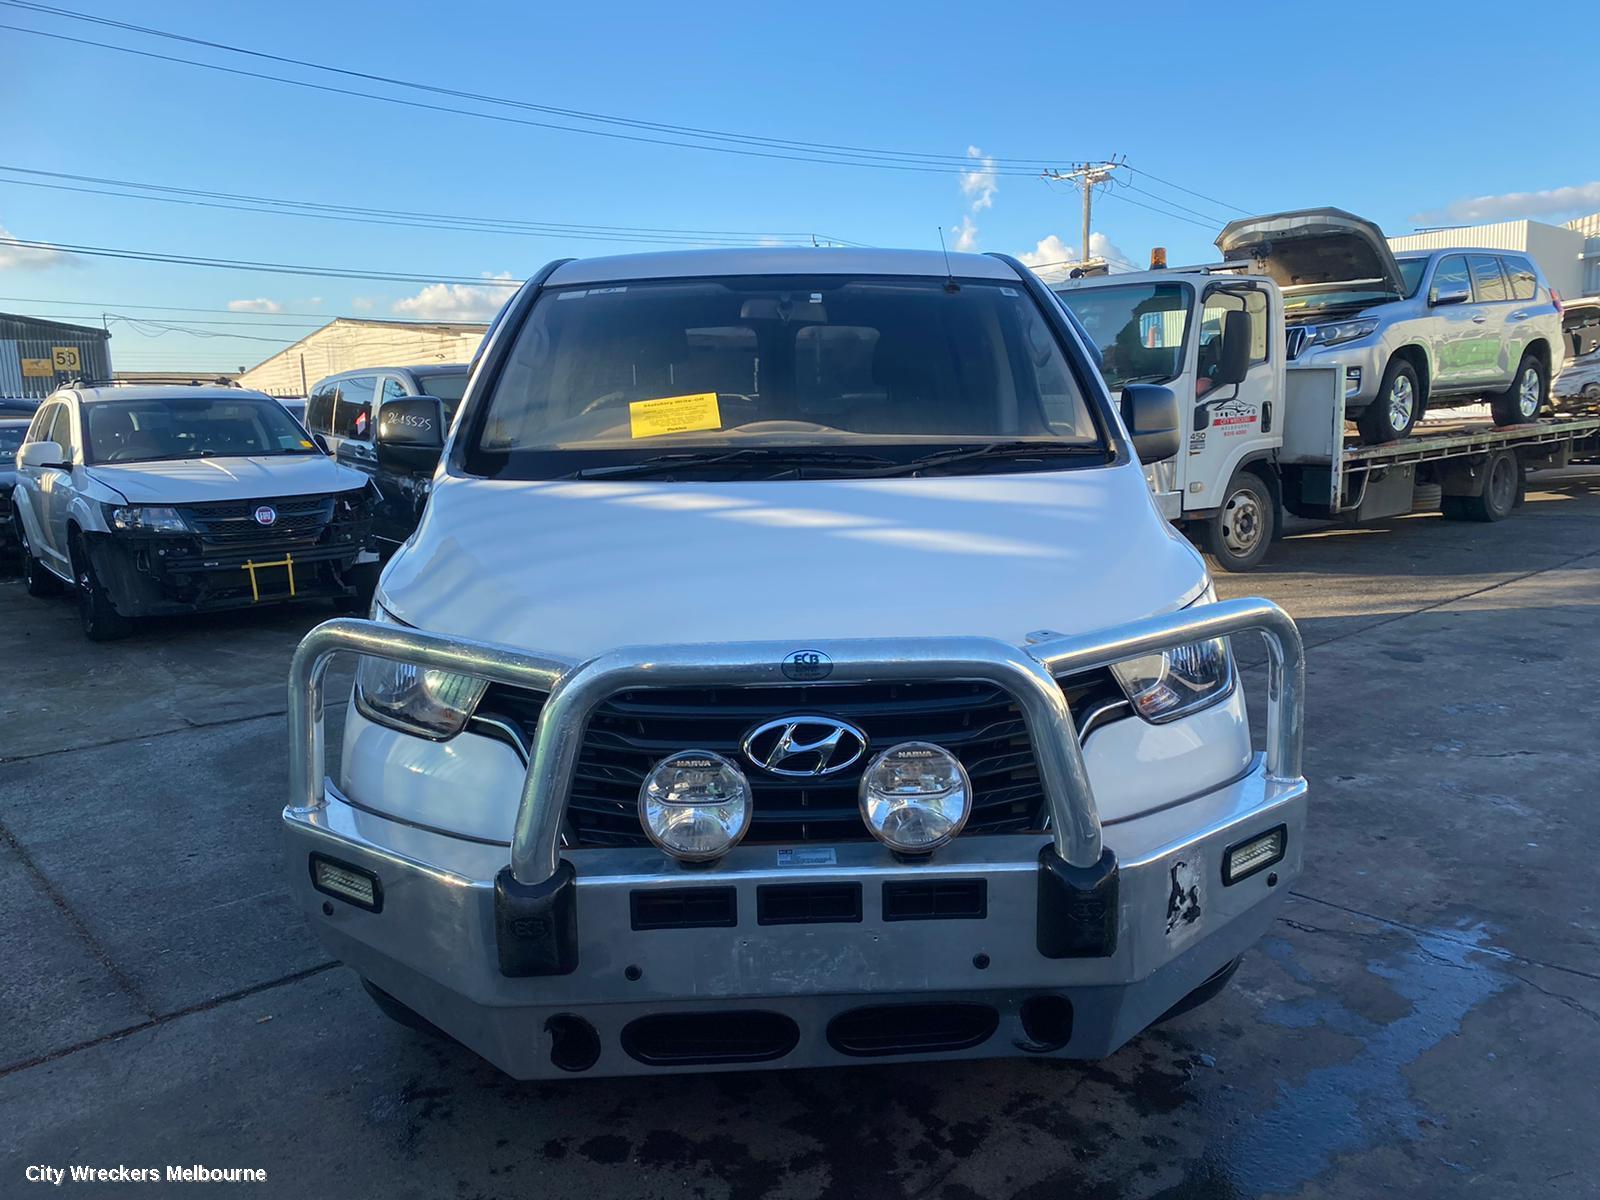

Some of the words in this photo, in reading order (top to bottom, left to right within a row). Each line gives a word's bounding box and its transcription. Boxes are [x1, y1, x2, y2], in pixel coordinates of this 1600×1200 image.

[56, 351, 77, 366] 50
[1190, 432, 1206, 440] 450
[793, 652, 820, 665] ECB
[898, 750, 933, 759] NARVA
